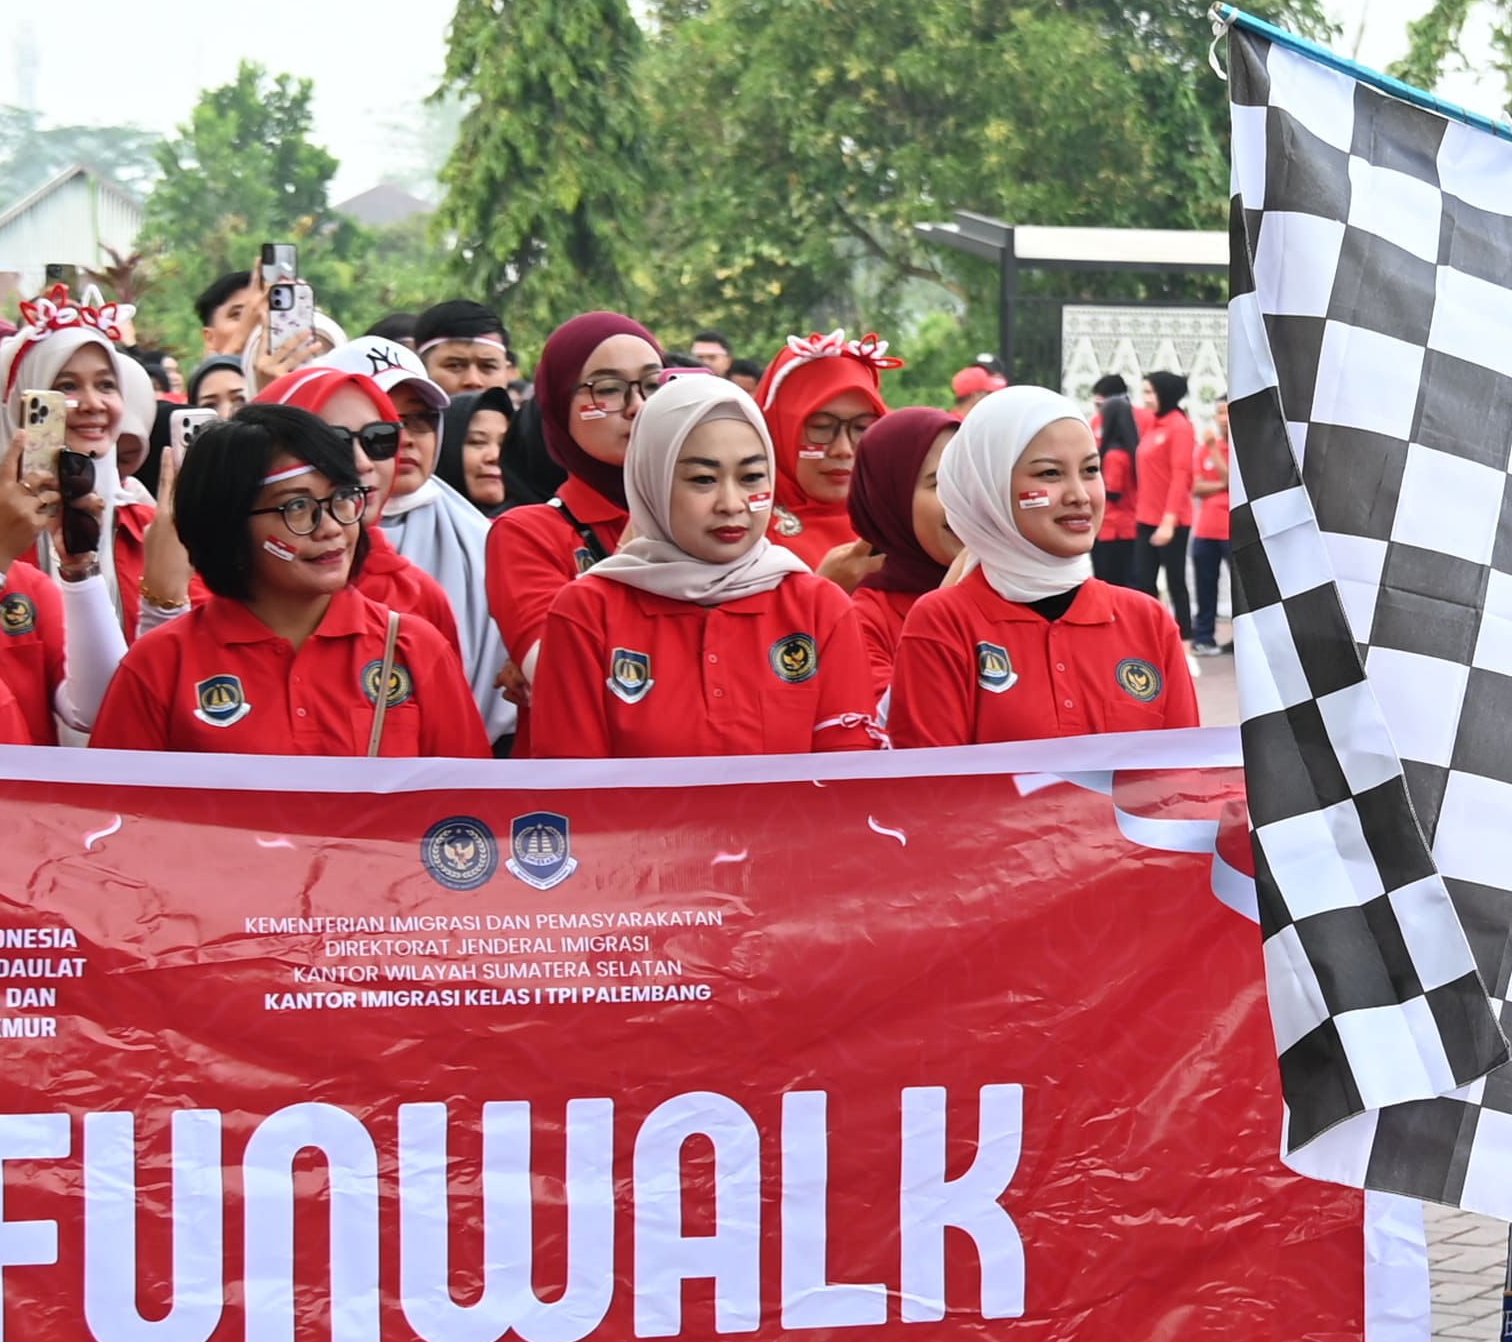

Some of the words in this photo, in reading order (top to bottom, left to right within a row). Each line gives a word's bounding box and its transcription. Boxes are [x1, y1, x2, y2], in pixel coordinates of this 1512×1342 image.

[244, 916, 385, 934] KEMENTERIAN
[390, 915, 480, 932] IMIGRASI
[486, 914, 530, 930] DAN
[536, 911, 723, 929] PEMASYARAKATAN
[325, 938, 450, 957] DIREKTORAT
[456, 936, 556, 955] JENDERAL
[561, 935, 650, 953] IMIGRASI
[294, 965, 379, 983] KANTOR
[384, 963, 477, 981] WILAYAH
[483, 961, 590, 979] SUMATERA
[596, 959, 682, 977] SELATAN
[5, 987, 57, 1008] DAN
[264, 991, 356, 1010] KANTOR
[361, 990, 460, 1008] IMIGRASI
[464, 988, 530, 1006] KELAS
[535, 988, 541, 1004] I
[545, 986, 578, 1004] TPI
[582, 984, 712, 1003] PALEMBANG
